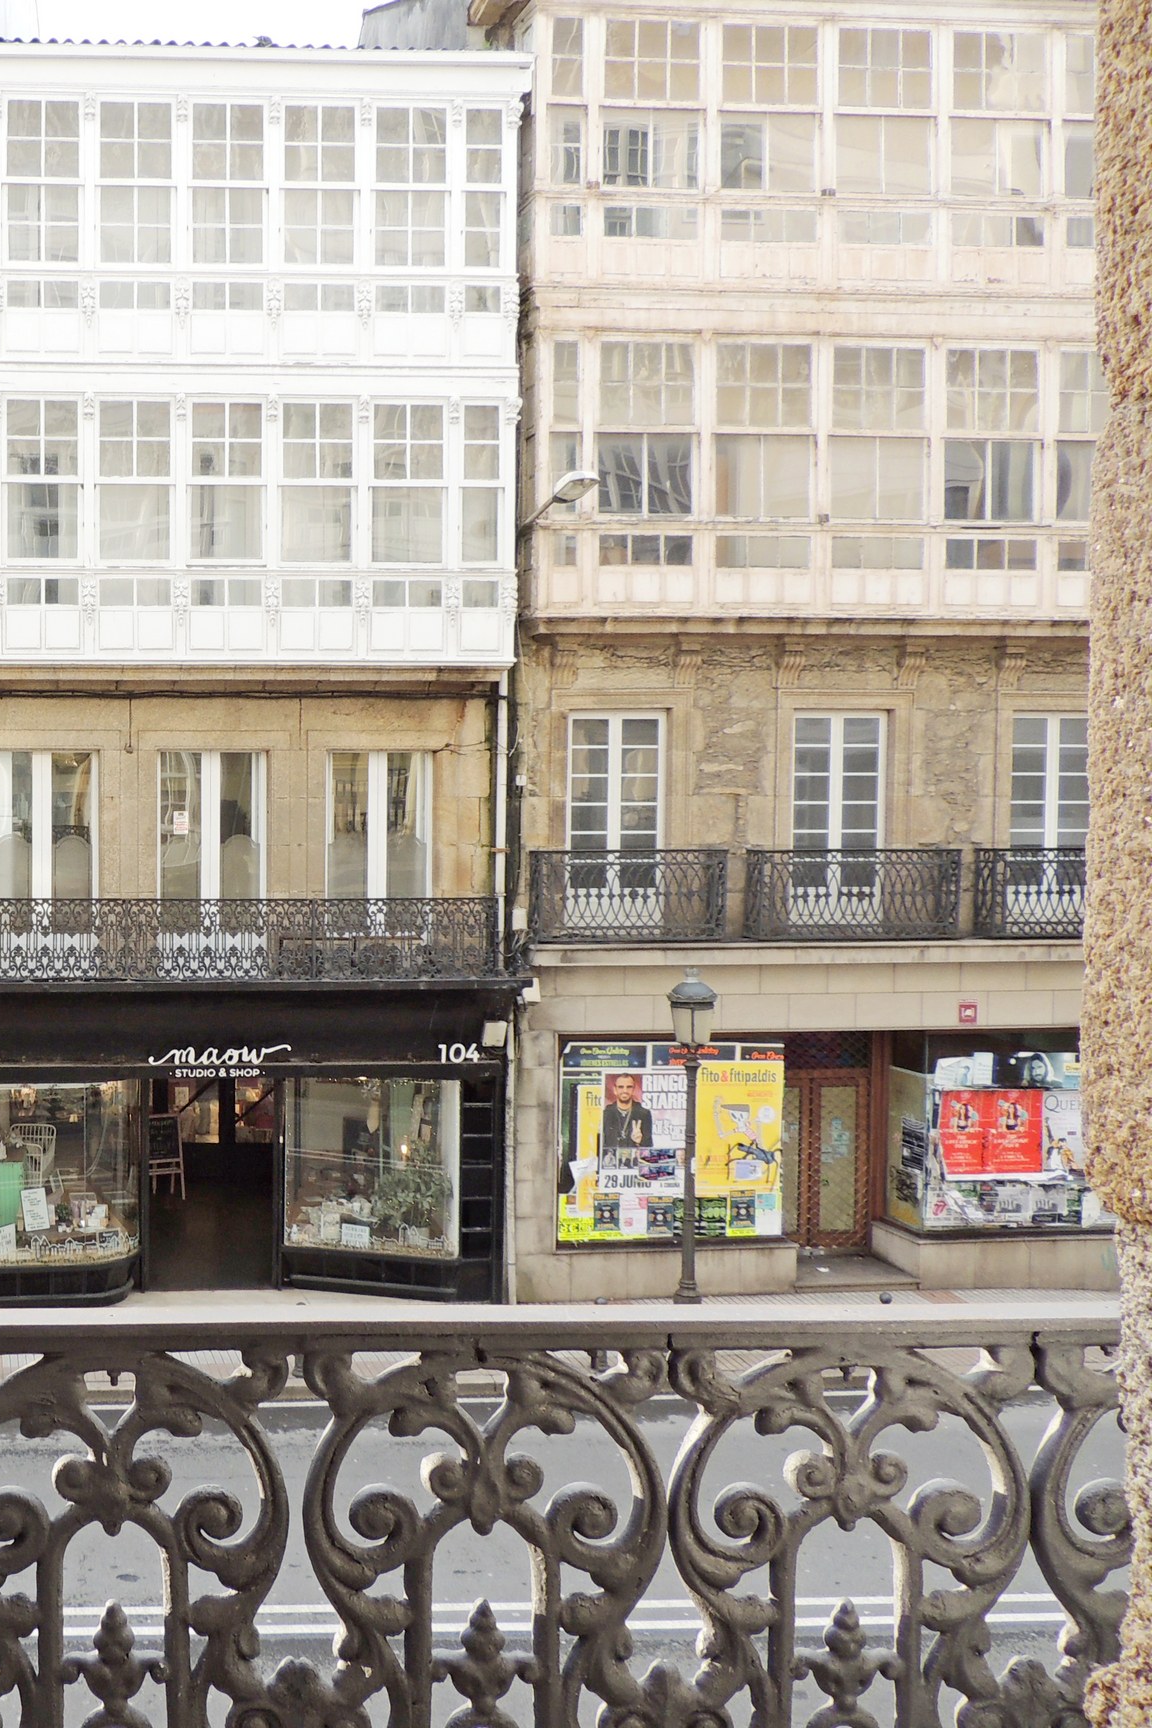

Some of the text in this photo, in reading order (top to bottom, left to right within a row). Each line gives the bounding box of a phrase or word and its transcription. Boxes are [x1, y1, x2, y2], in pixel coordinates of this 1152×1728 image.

[148, 1044, 292, 1065] maow
[438, 1043, 480, 1064] 104
[175, 1068, 260, 1078] STUDIO & SHOP
[642, 1073, 688, 1092] RINGO
[701, 1067, 777, 1086] fito & fitipaldis
[641, 1092, 688, 1111] STARR
[1044, 1094, 1082, 1113] QUE
[604, 1174, 618, 1189] 29
